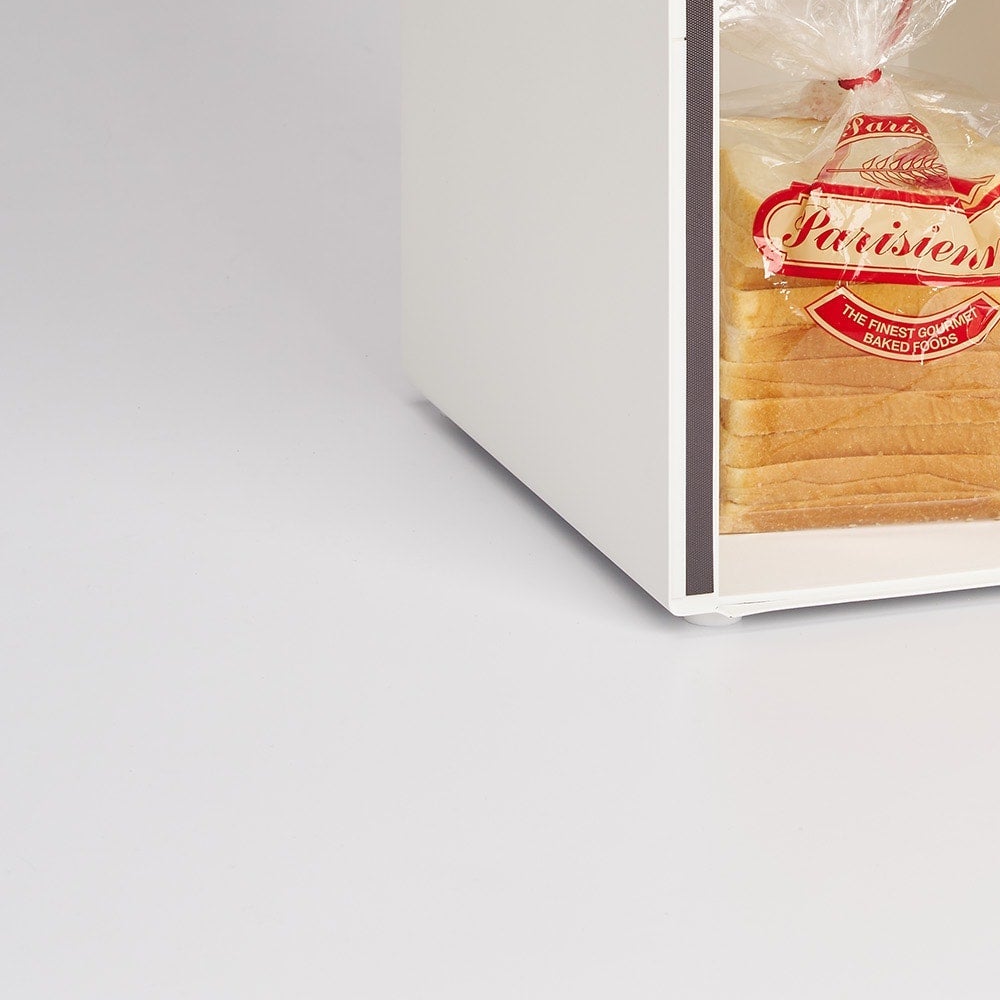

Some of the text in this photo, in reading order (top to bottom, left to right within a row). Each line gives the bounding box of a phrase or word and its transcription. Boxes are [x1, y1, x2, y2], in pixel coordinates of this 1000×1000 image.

[842, 304, 978, 340] THE FINEST GOURMET
[863, 332, 959, 354] BAKED FOODS
